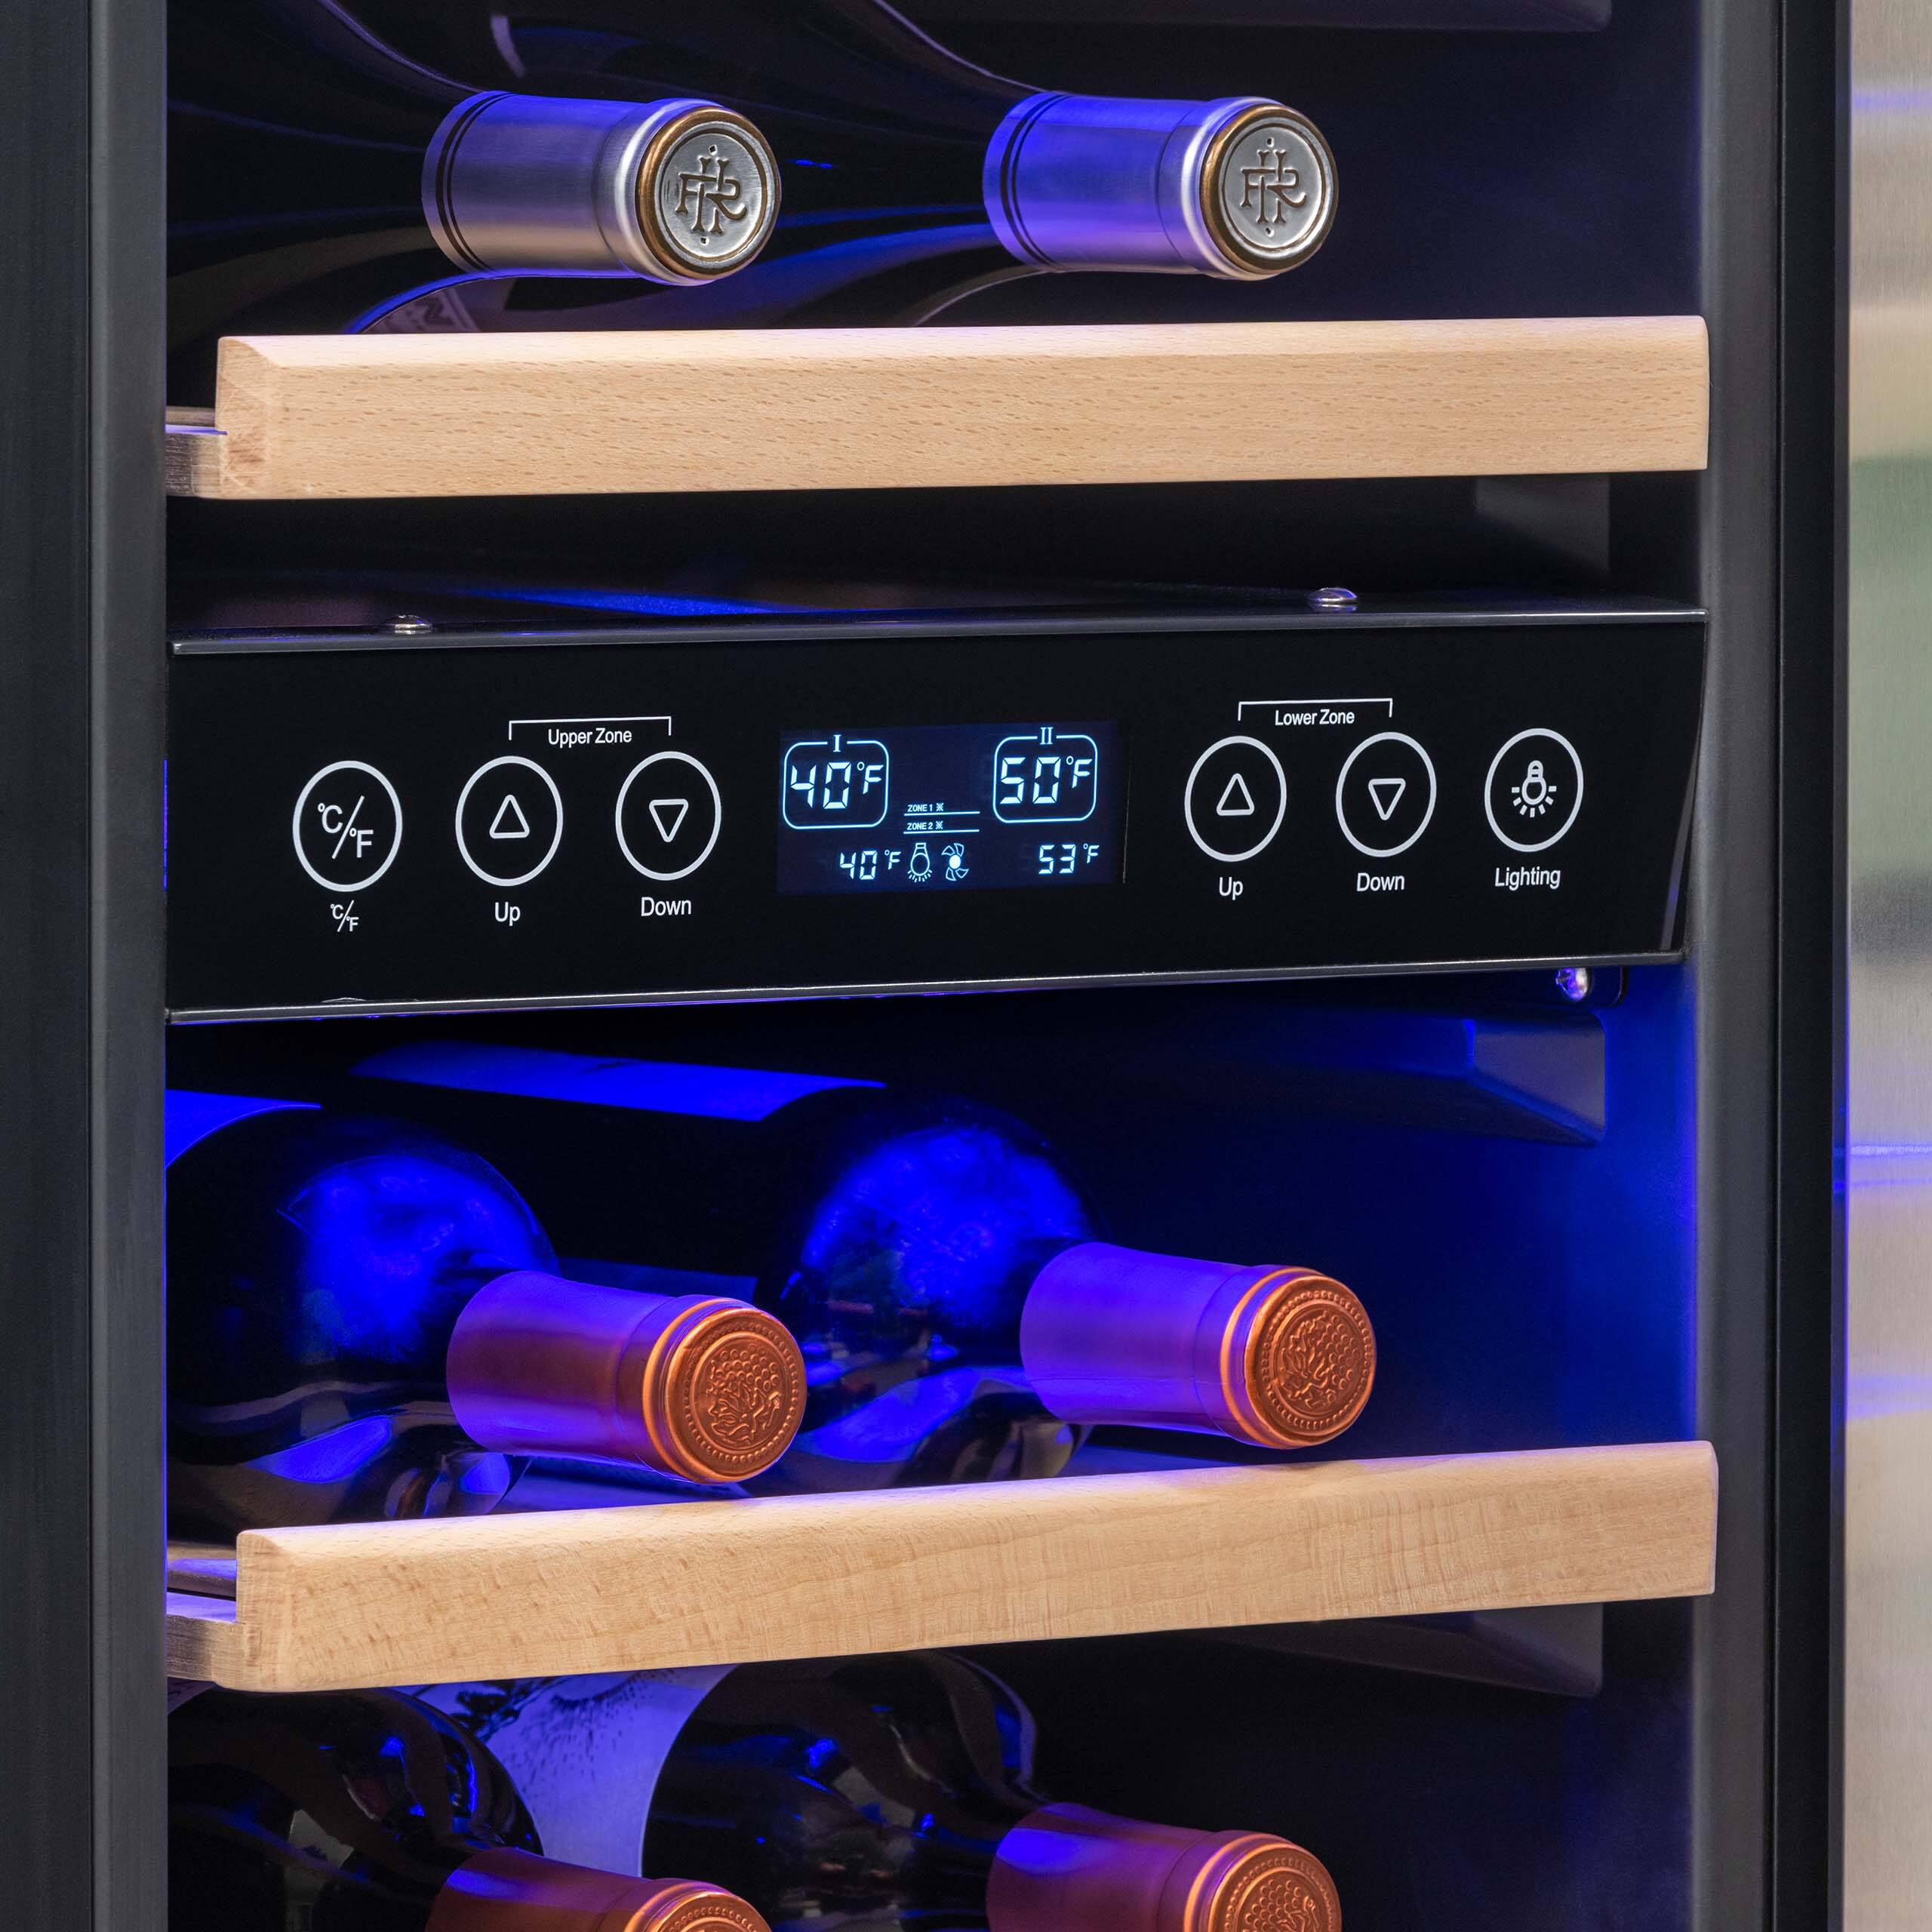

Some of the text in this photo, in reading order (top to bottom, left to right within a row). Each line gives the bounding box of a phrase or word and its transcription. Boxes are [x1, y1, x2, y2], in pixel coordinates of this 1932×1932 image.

[1275, 709, 1355, 726] Lower Zone
[548, 727, 632, 749] Upper Zone
[907, 804, 934, 813] ZONE 1
[906, 822, 934, 831] ZONE 2
[1219, 876, 1244, 900] Up
[1356, 872, 1405, 892] Down
[1494, 866, 1561, 891] Lighting
[494, 901, 521, 927] Up
[641, 897, 692, 917] Down
